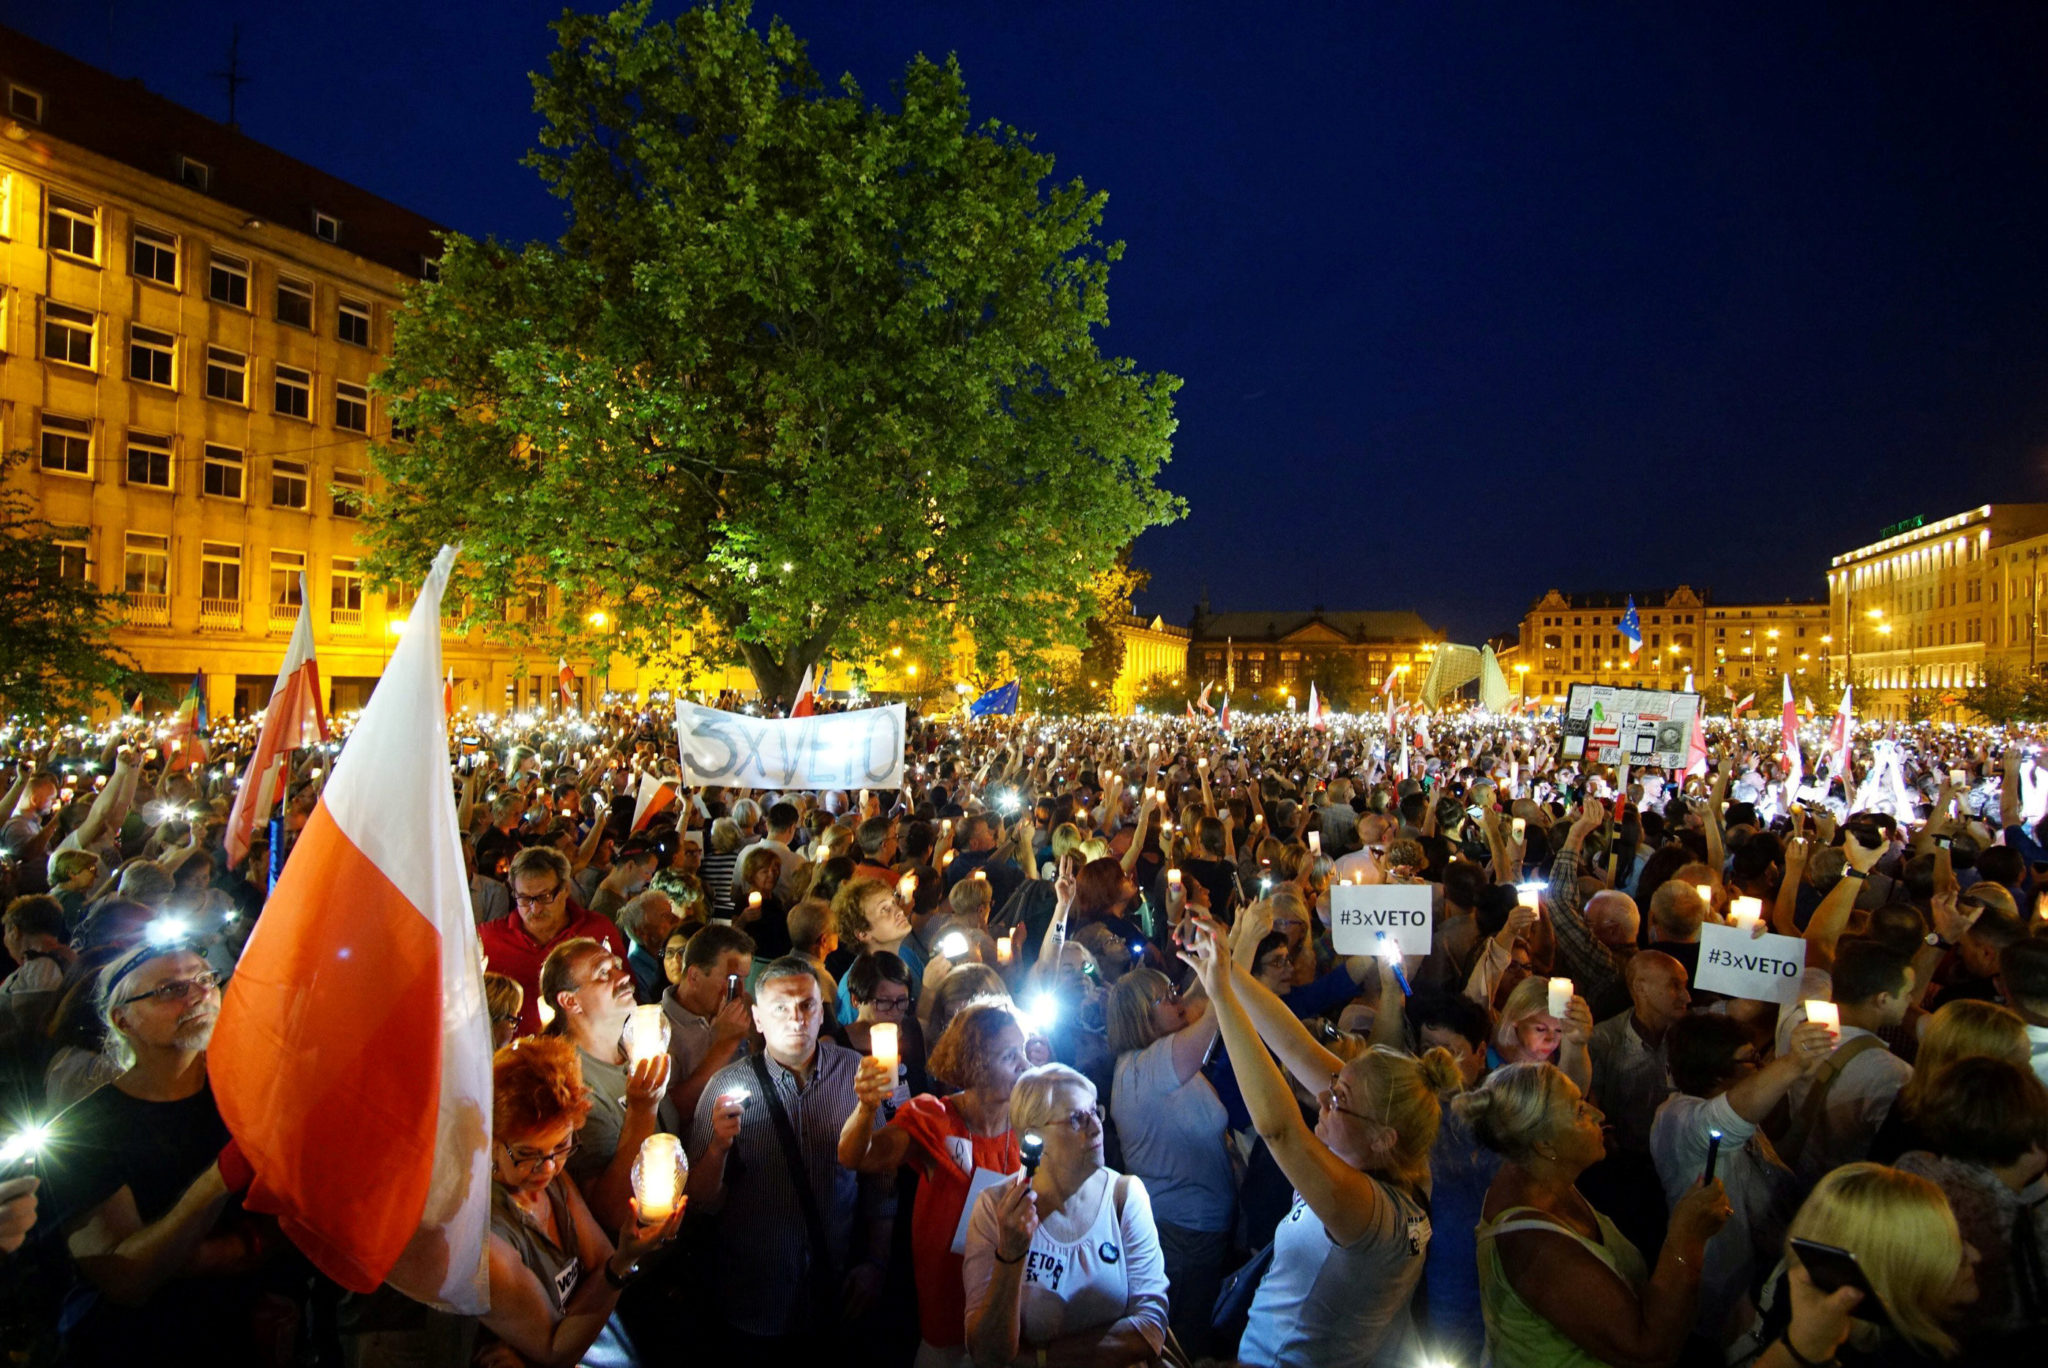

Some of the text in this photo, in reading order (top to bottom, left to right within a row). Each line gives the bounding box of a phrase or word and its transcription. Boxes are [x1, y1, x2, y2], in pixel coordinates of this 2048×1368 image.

[1340, 909, 1426, 927] #3xVETO
[1708, 948, 1798, 978] #3xVETO
[1027, 1250, 1055, 1271] ETO
